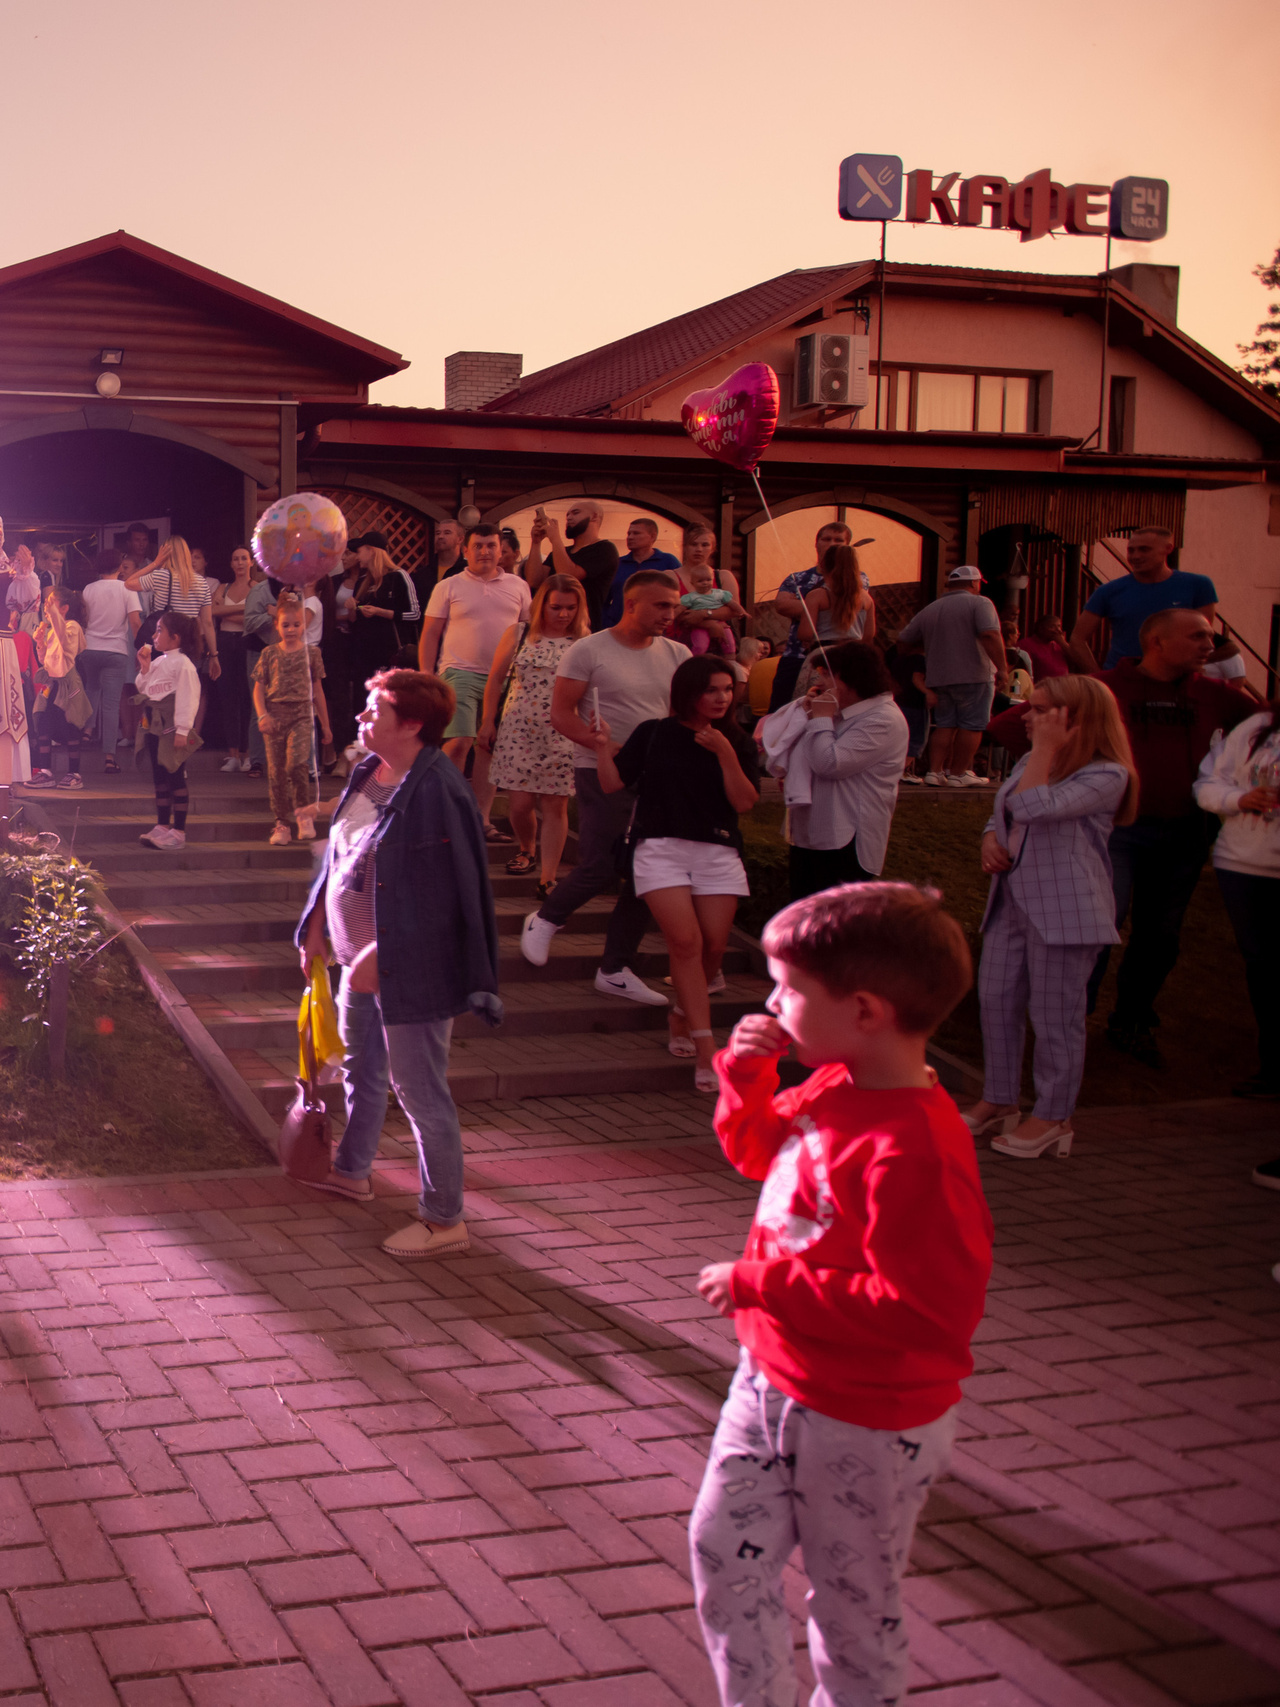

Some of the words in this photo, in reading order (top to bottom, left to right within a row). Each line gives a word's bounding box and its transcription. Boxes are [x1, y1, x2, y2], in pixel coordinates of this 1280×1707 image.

[907, 168, 1111, 243] КАФЕ
[1132, 187, 1160, 216] 24
[1130, 216, 1159, 228] ЧАСА
